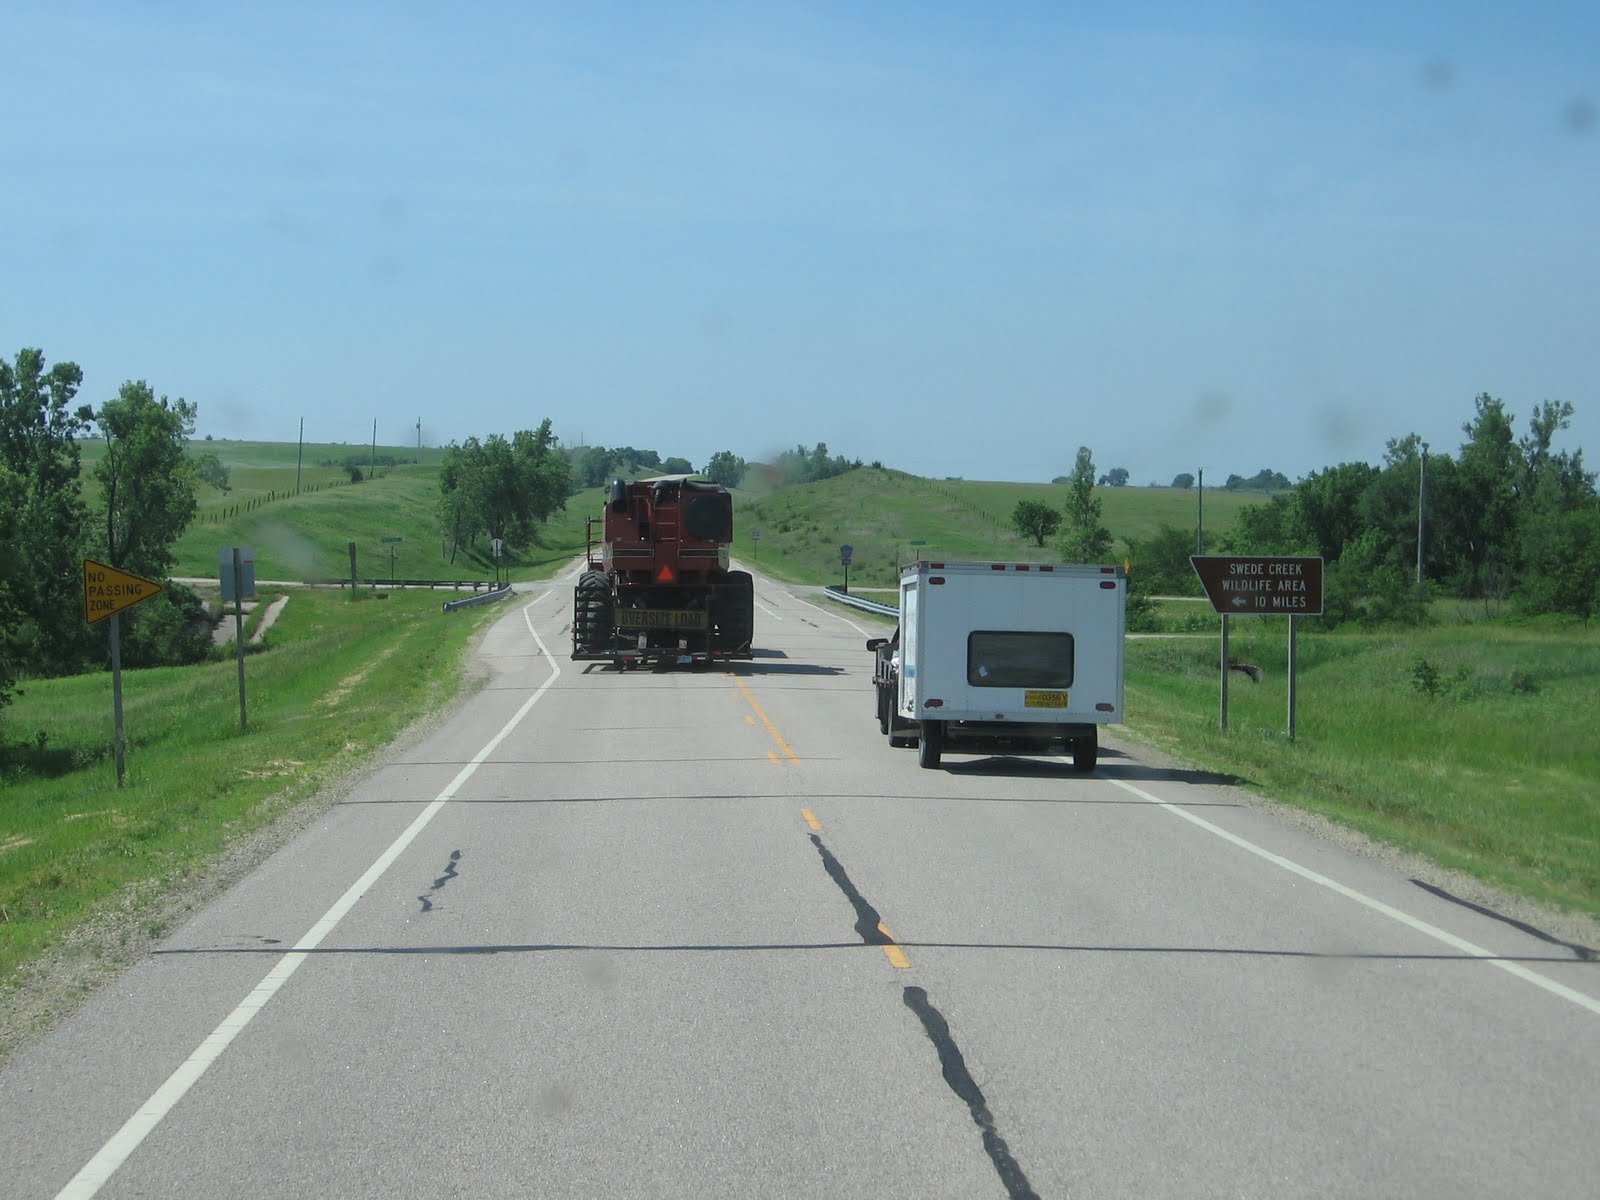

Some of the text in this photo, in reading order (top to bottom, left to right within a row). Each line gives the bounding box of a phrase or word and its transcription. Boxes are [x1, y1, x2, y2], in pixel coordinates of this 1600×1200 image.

[1229, 563, 1302, 575] SWEDE CREEK
[88, 572, 105, 583] NO
[88, 584, 143, 597] PASSING
[1222, 579, 1306, 591] WILDLIFE AREA
[89, 600, 115, 611] ZONE
[1255, 596, 1306, 608] 10 MILES
[675, 612, 701, 625] LOAD
